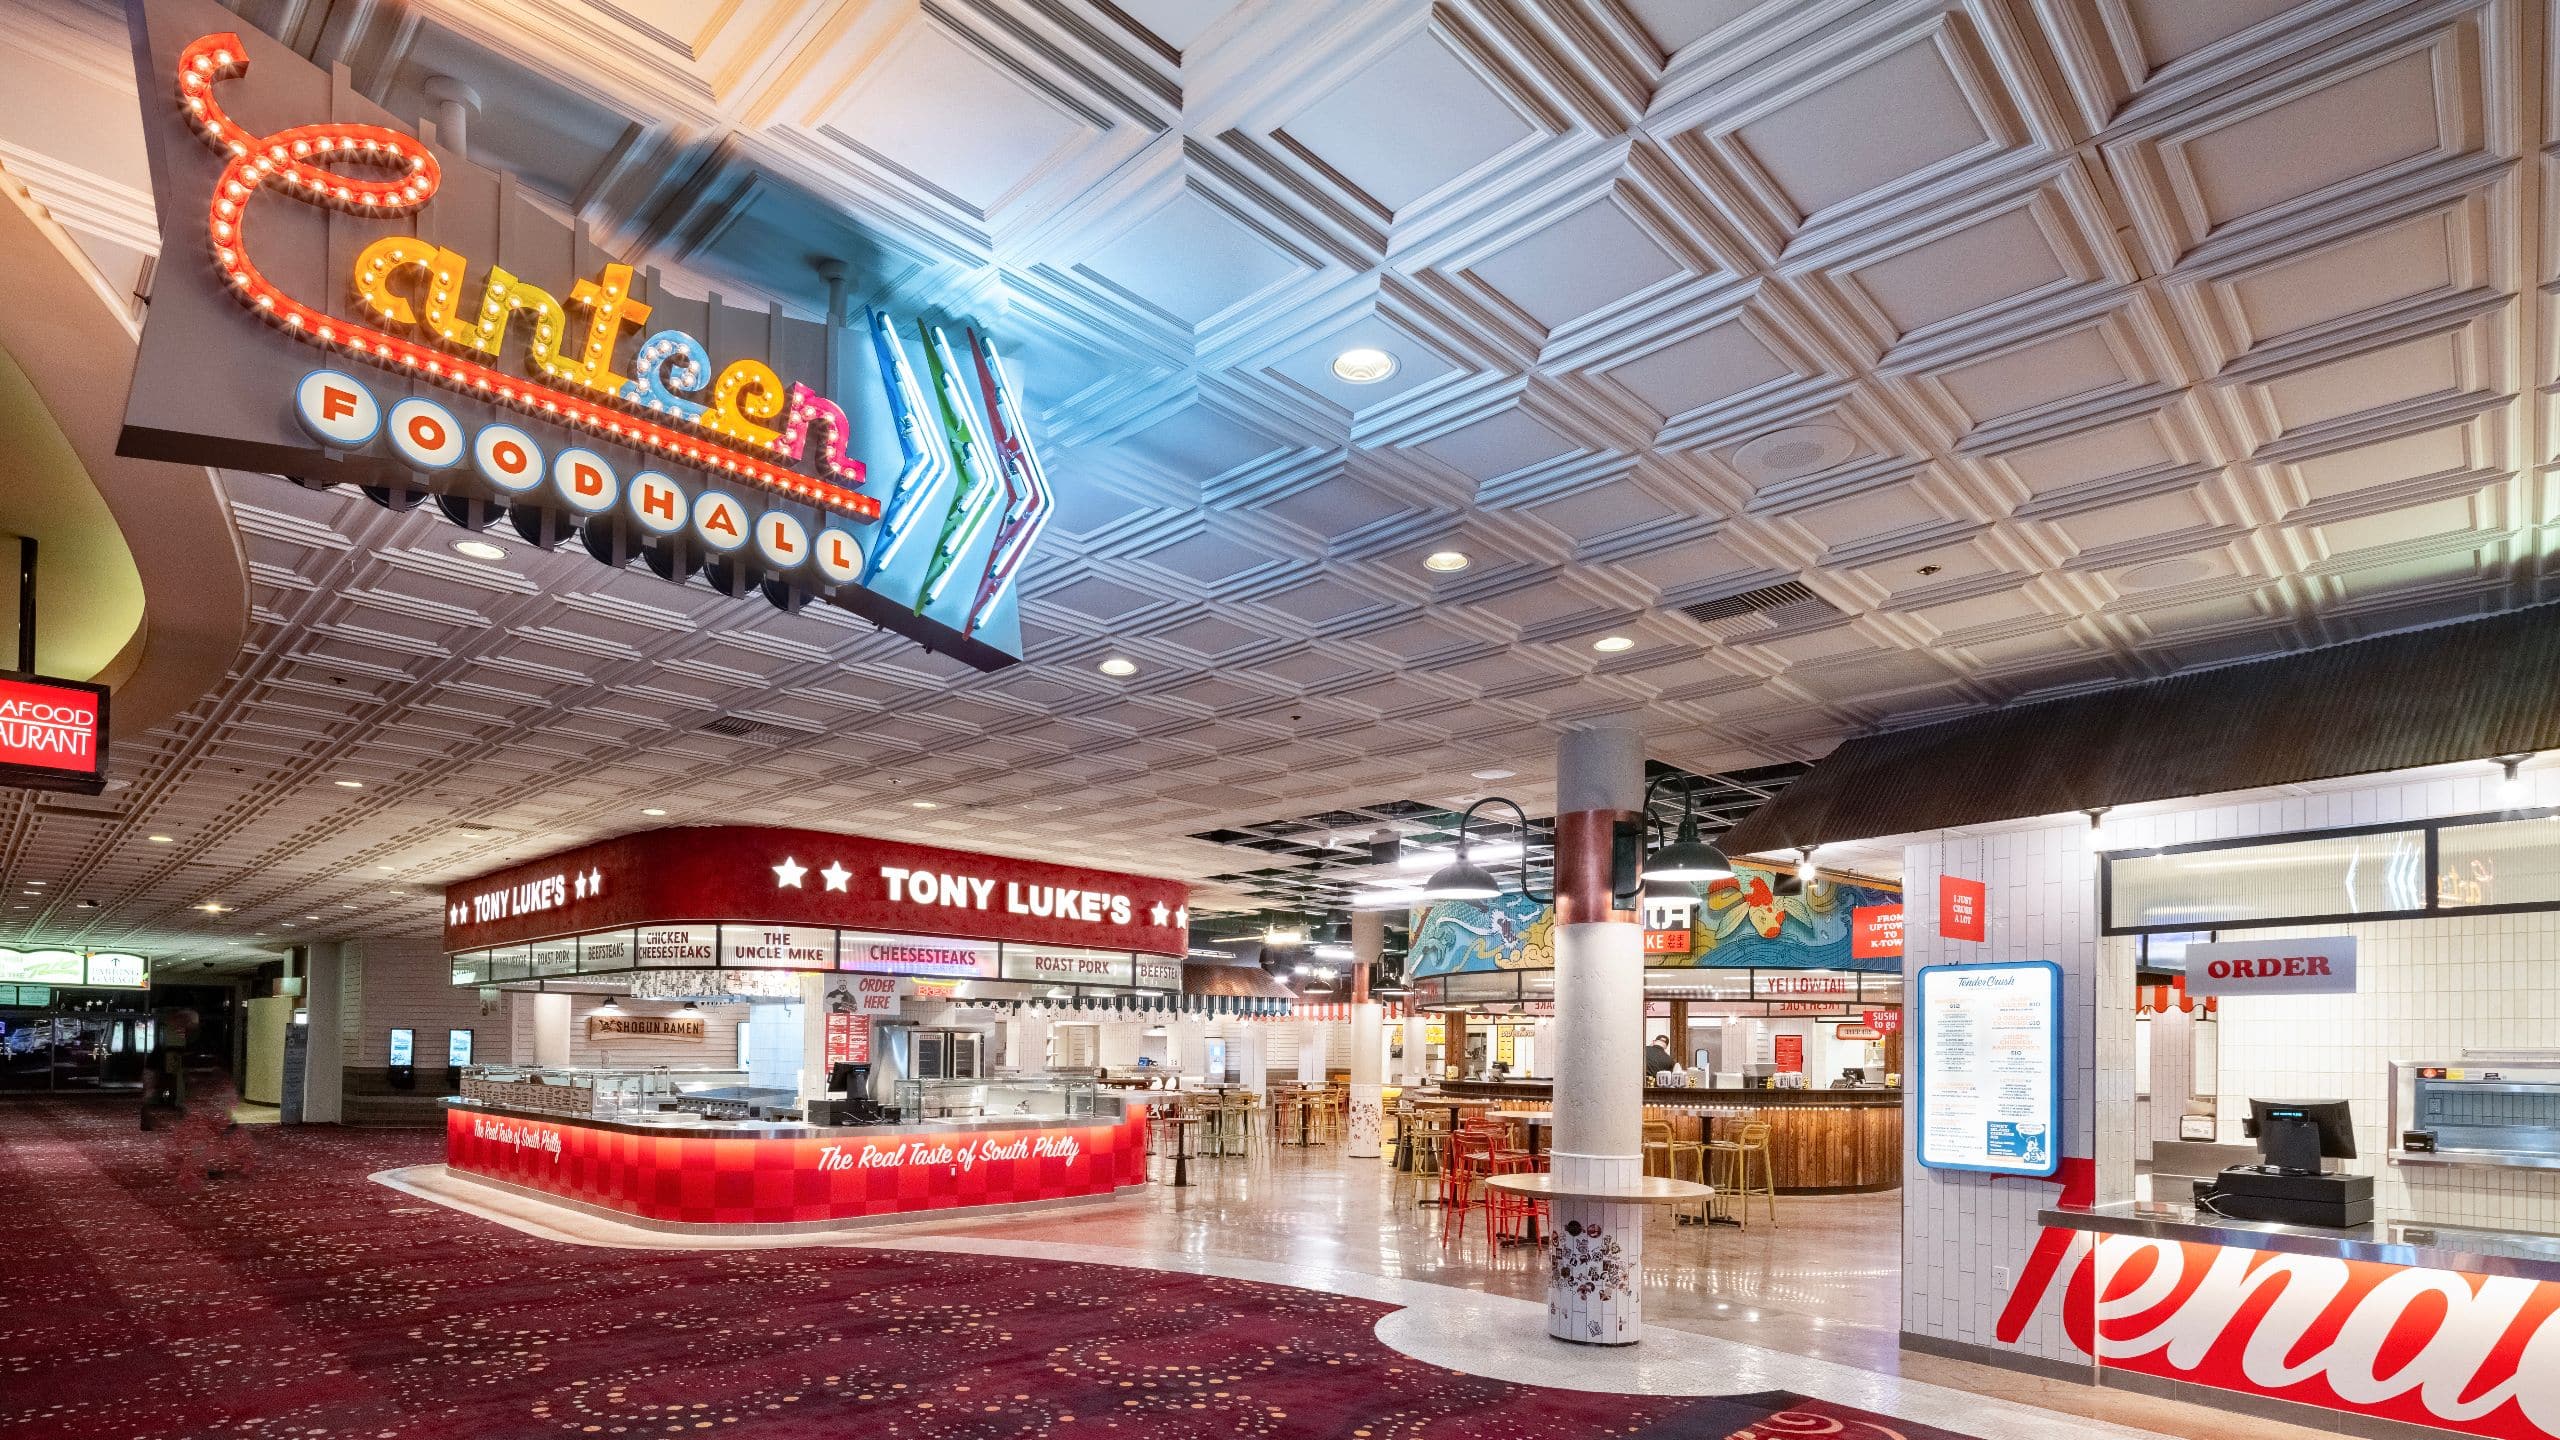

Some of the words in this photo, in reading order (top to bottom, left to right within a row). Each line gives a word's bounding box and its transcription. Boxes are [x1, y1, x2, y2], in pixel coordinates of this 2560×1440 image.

[178, 31, 881, 520] Canteen
[473, 892, 509, 924] TONY
[511, 874, 566, 916] LUKE'S
[881, 866, 996, 911] TONY
[1008, 882, 1131, 925] LUKE'S
[1957, 895, 1973, 905] JUST
[1876, 914, 1903, 923] FROM
[646, 931, 690, 945] CHICKEN
[763, 932, 791, 945] THE
[1883, 931, 1897, 939] TO
[537, 951, 554, 965] ROAST
[555, 949, 571, 963] PORK
[588, 942, 625, 960] BEEFSTEAKS
[638, 945, 712, 960] CHEESESTEAKS
[735, 945, 781, 959] UNCLE
[788, 947, 824, 961] MIKE
[870, 945, 976, 966] CHEESESTEAKS
[1035, 956, 1075, 973] ROAST
[1078, 959, 1110, 975] PORK
[2207, 955, 2332, 979] ORDER
[859, 977, 896, 993] ORDER
[1767, 977, 1846, 993] YELLOWTAIL
[863, 995, 891, 1009] HERE
[1872, 1012, 1897, 1021] SUSHI
[615, 1019, 661, 1035] SHOGUN
[664, 1021, 699, 1036] RAMEN
[1874, 1021, 1883, 1029] to
[1885, 1022, 1896, 1031] go
[473, 1119, 485, 1137] The
[485, 1121, 499, 1141] Real
[499, 1123, 514, 1144] Taste
[514, 1126, 521, 1153] of
[520, 1127, 540, 1150] South
[541, 1129, 562, 1164] Philly
[818, 1145, 855, 1171] The
[857, 1143, 906, 1170] Real
[908, 1141, 954, 1167] Taste
[956, 1139, 977, 1172] of
[979, 1137, 1029, 1163] South
[1032, 1135, 1080, 1168] Philly
